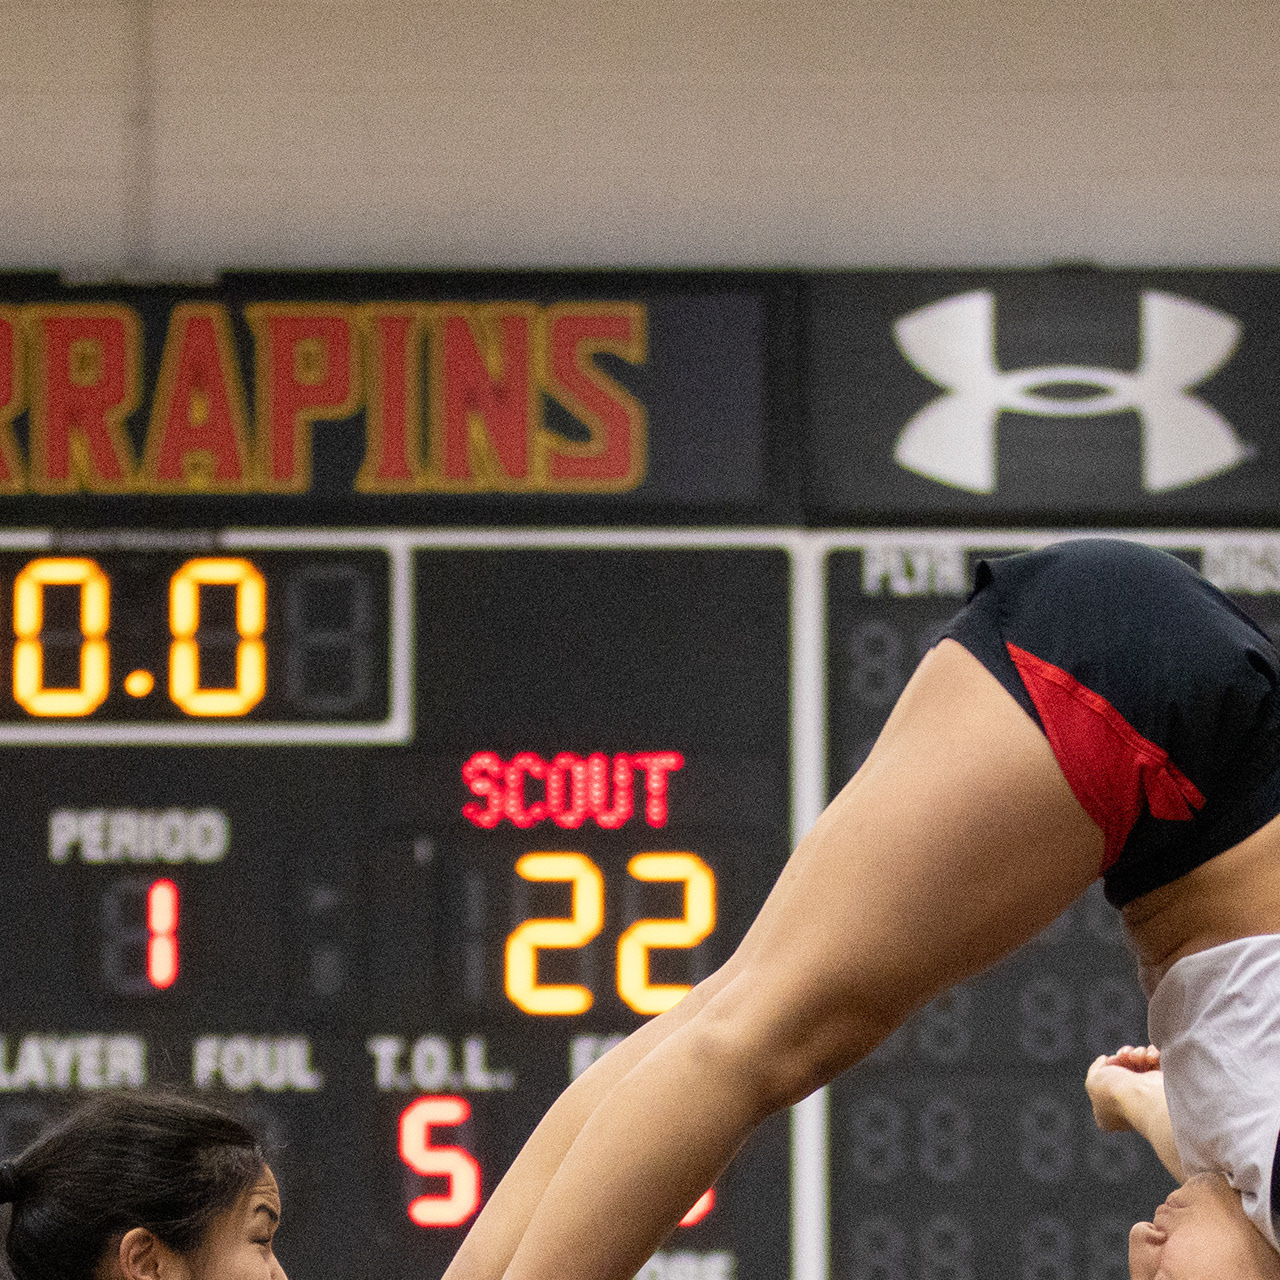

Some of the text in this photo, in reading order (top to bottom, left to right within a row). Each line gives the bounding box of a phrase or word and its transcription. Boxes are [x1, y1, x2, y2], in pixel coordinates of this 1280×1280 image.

[462, 751, 685, 829] SCOUT
[48, 808, 231, 863] PERIOD
[147, 877, 180, 989] 1
[504, 851, 716, 1016] 22
[192, 1032, 323, 1091] FOUL
[366, 1034, 514, 1091] T.O.L.
